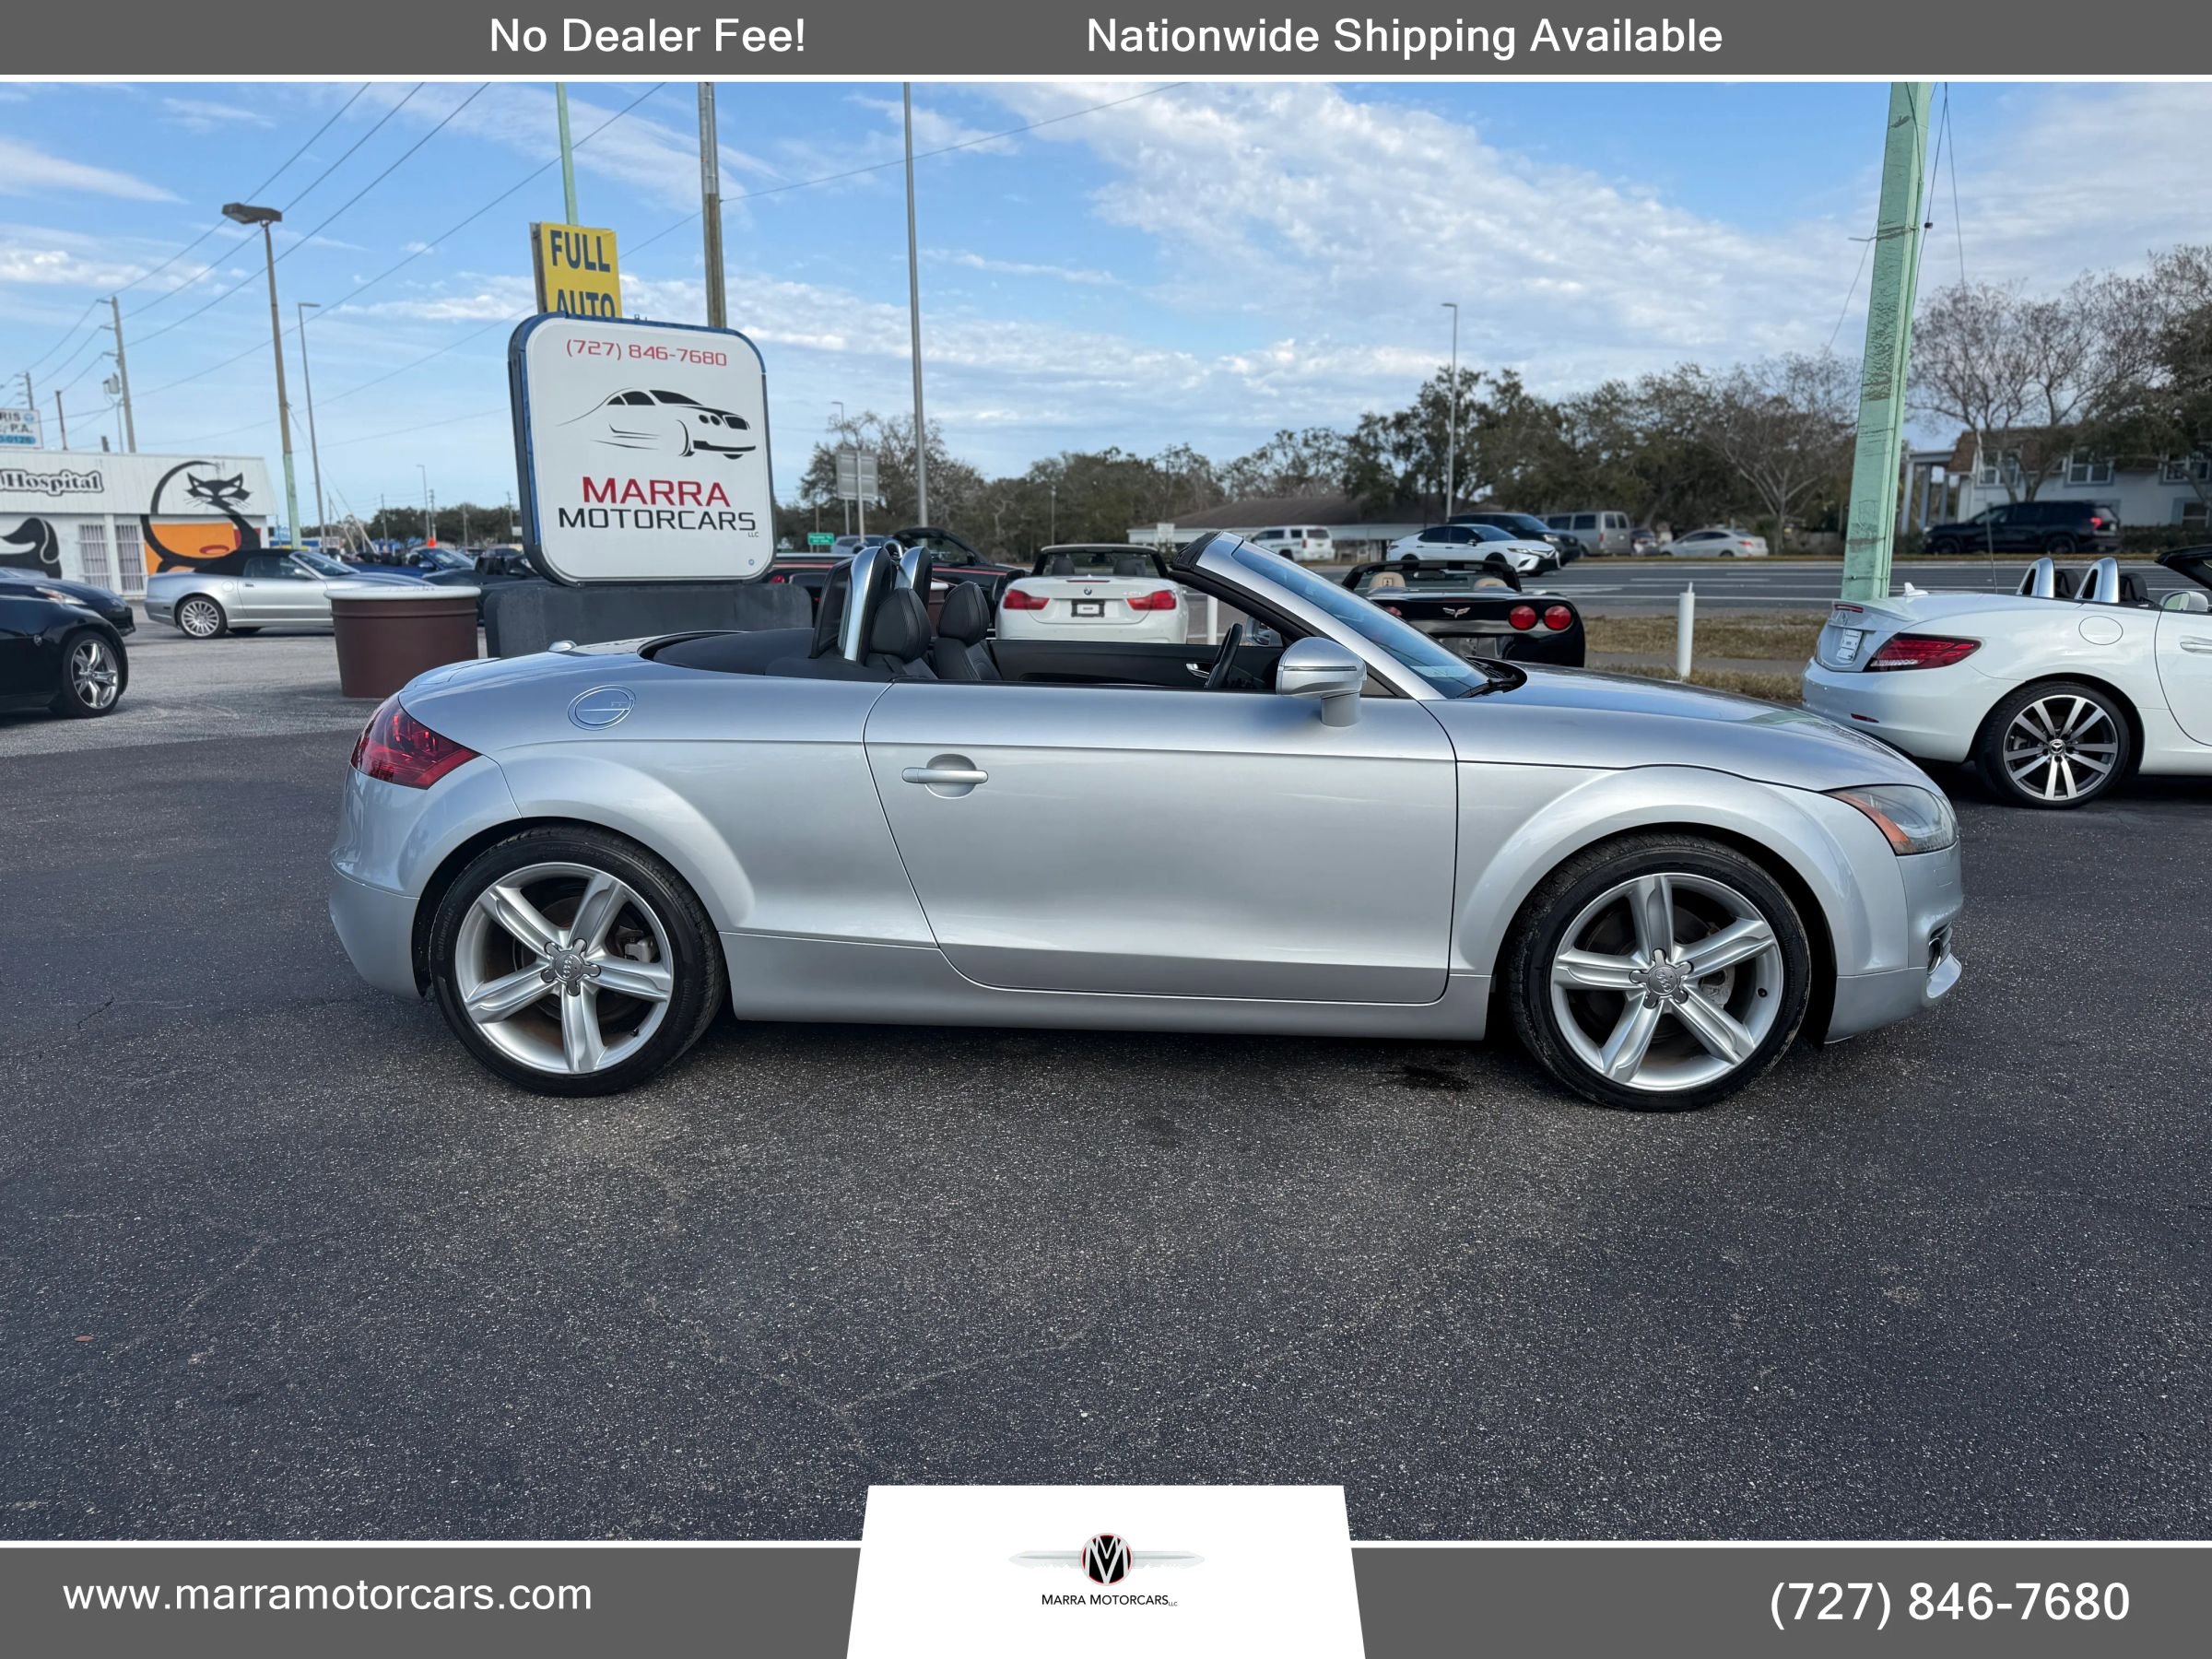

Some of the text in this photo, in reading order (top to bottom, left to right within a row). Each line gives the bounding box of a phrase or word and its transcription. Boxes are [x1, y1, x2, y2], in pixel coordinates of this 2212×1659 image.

[550, 229, 611, 273] FULL
[557, 288, 616, 318] AUTO
[566, 339, 727, 367] (727) 846-7680
[5, 471, 101, 494] Hospital
[582, 476, 732, 508] MARRA
[558, 507, 756, 532] MOTORCARS
